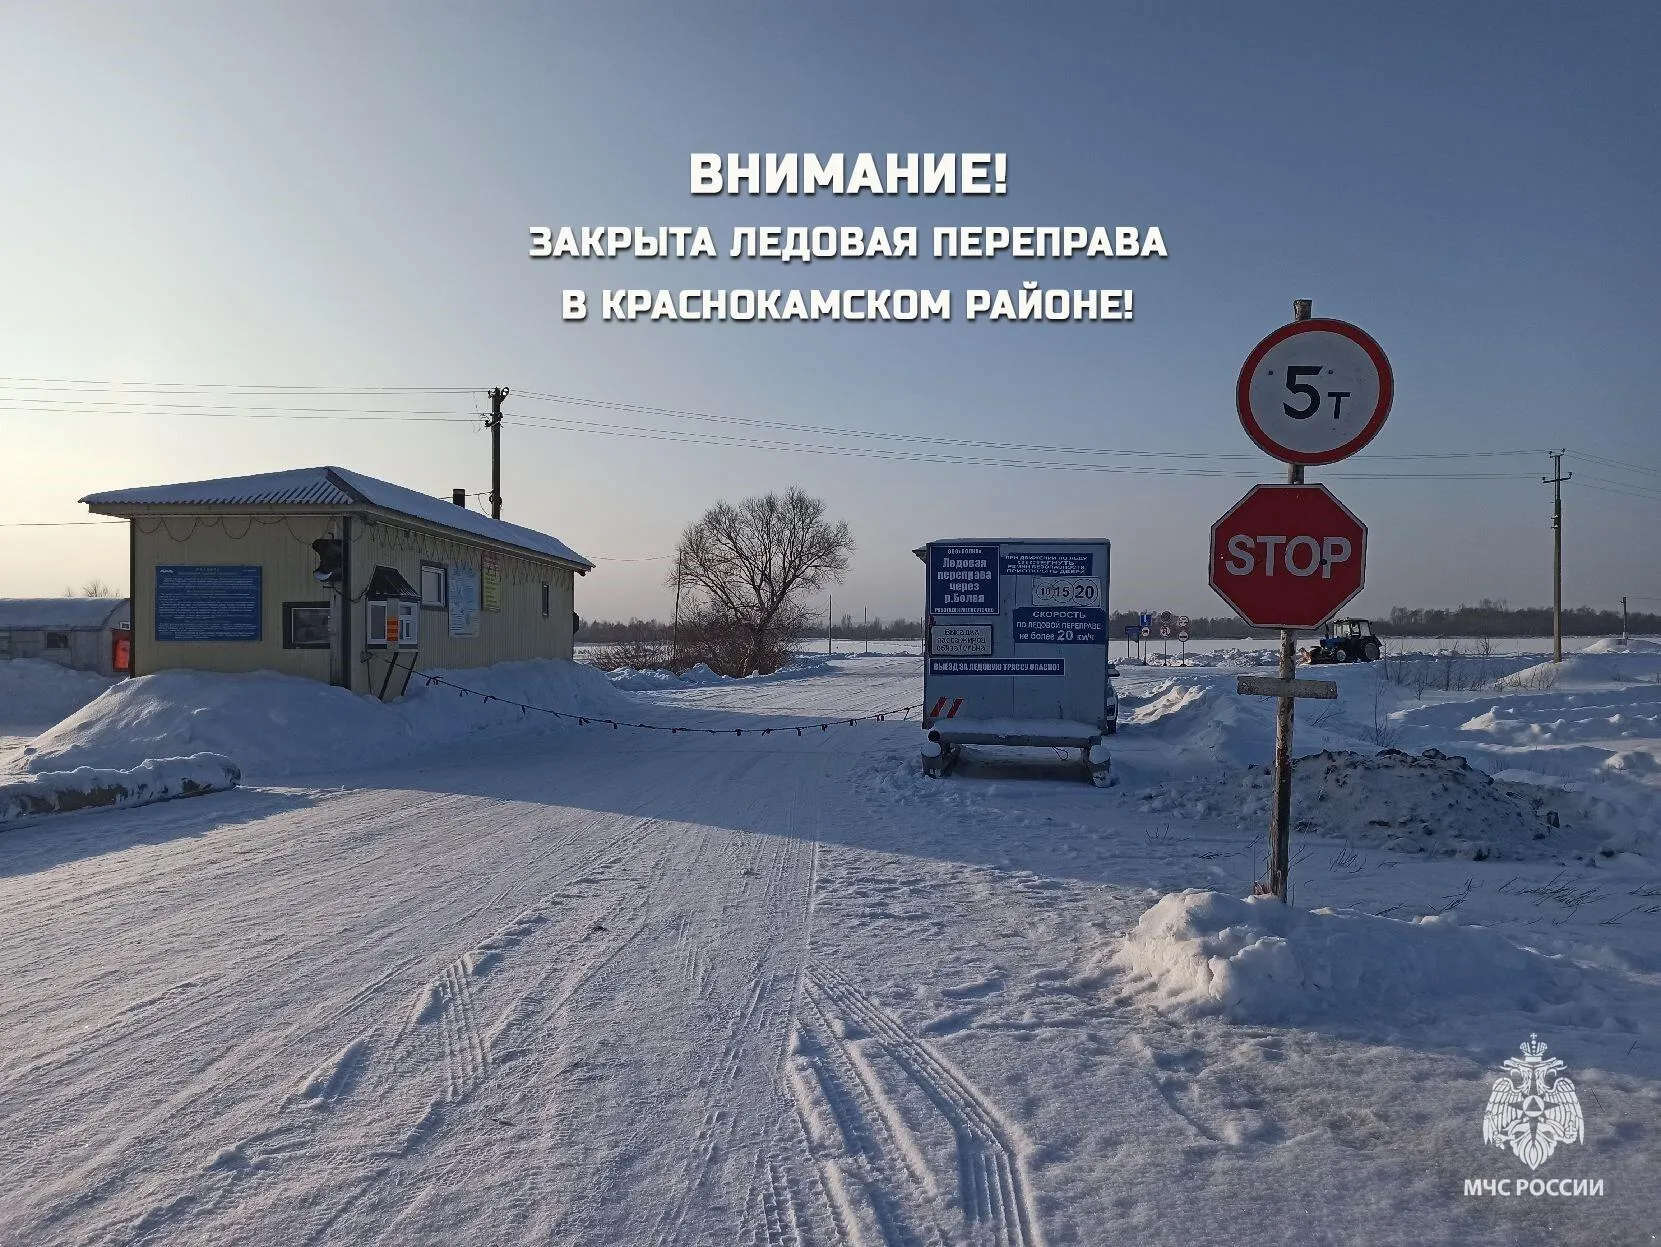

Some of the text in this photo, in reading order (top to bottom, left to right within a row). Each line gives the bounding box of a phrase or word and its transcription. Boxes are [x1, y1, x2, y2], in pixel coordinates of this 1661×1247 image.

[1225, 534, 1352, 579] STOP
[942, 557, 987, 569] Ледовая
[937, 570, 992, 580] переправа
[949, 582, 980, 592] через
[1041, 585, 1095, 599] 10 15 20
[1033, 611, 1086, 619] СКОРОСТЬ
[1028, 621, 1060, 629] ЛЕДОВОЙ
[1030, 631, 1055, 640] более
[1057, 630, 1074, 641] 20
[933, 662, 958, 672] ВЫЕЗД
[969, 663, 1001, 672] ЛЕДОВУЮ
[1003, 663, 1028, 671] ТРАССУ
